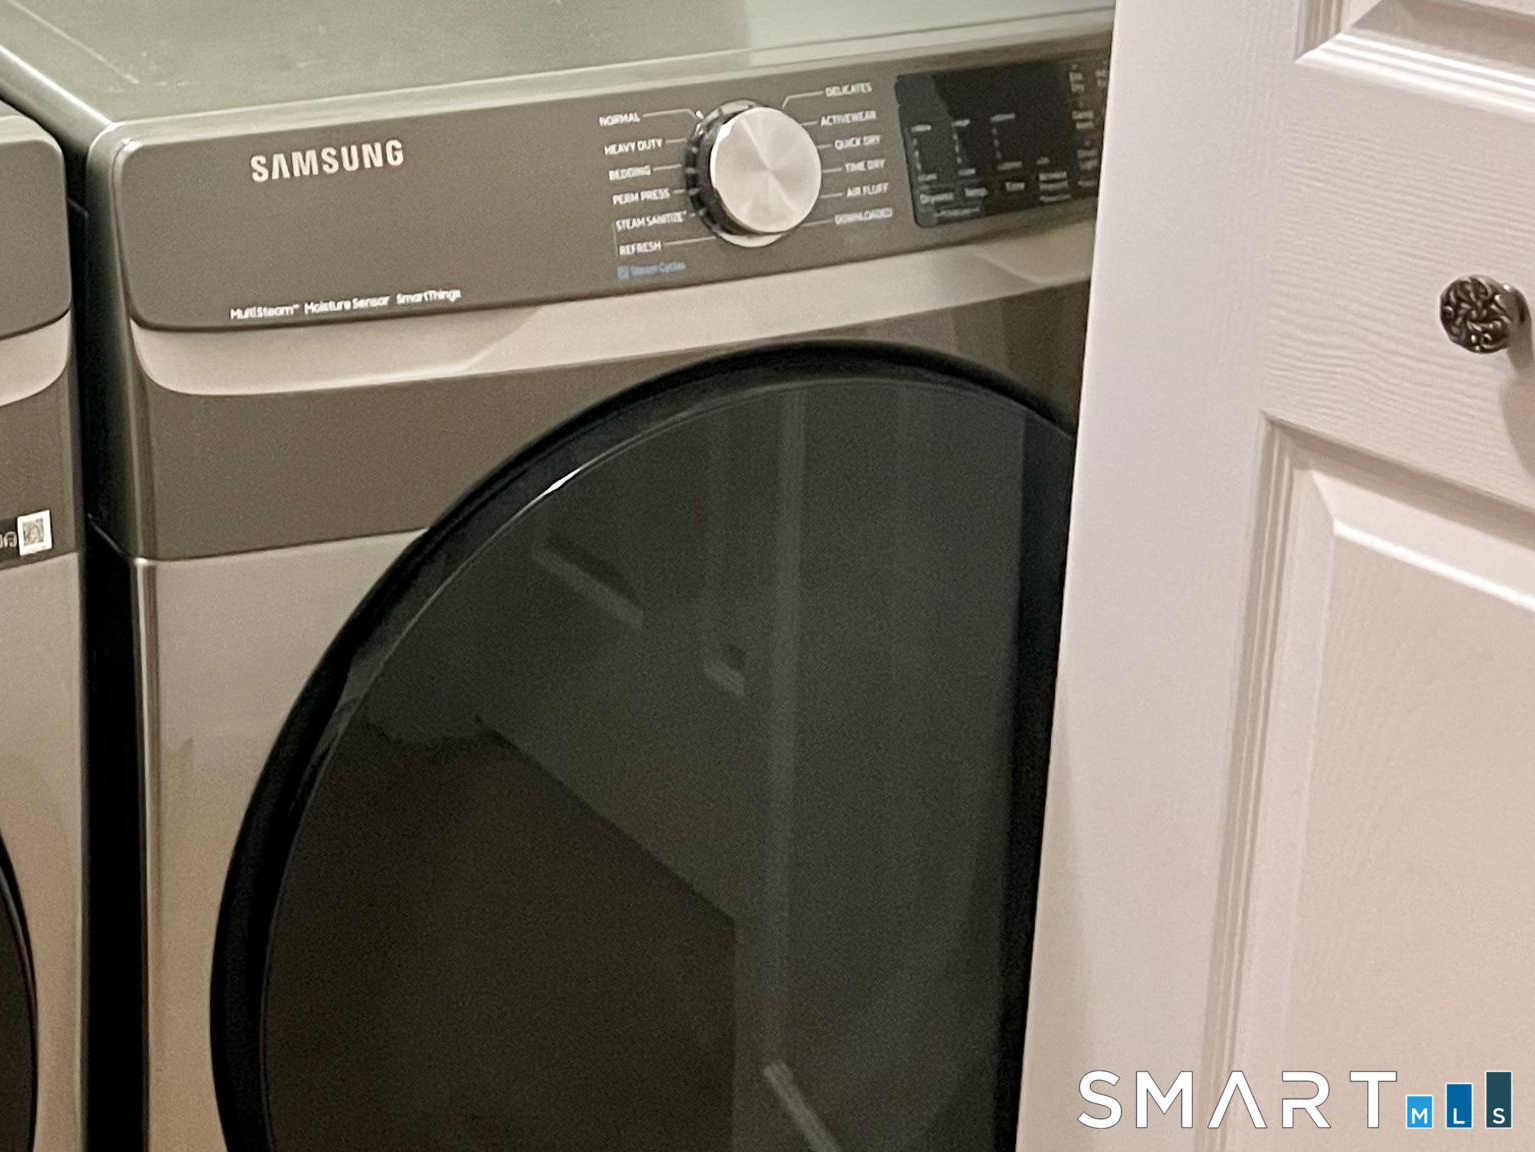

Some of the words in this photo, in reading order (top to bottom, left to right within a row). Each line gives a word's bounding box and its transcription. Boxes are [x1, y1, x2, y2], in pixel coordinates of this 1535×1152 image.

[824, 81, 873, 97] DELICATES
[599, 112, 641, 126] NORMAL
[604, 141, 636, 155] HEAVY
[636, 138, 663, 151] DUTY
[834, 136, 861, 150] QUICK
[250, 139, 404, 182] SAMSUNG
[867, 158, 886, 169] DRY
[612, 192, 639, 205] PERM
[640, 187, 671, 201] PRESS
[846, 186, 861, 197] AIR
[862, 182, 889, 195] FLUFF
[615, 216, 645, 232] STEAM
[619, 240, 662, 256] REFRESH
[304, 299, 351, 315] Moisture
[352, 296, 391, 310] Sensor
[396, 289, 462, 305] SmartThings
